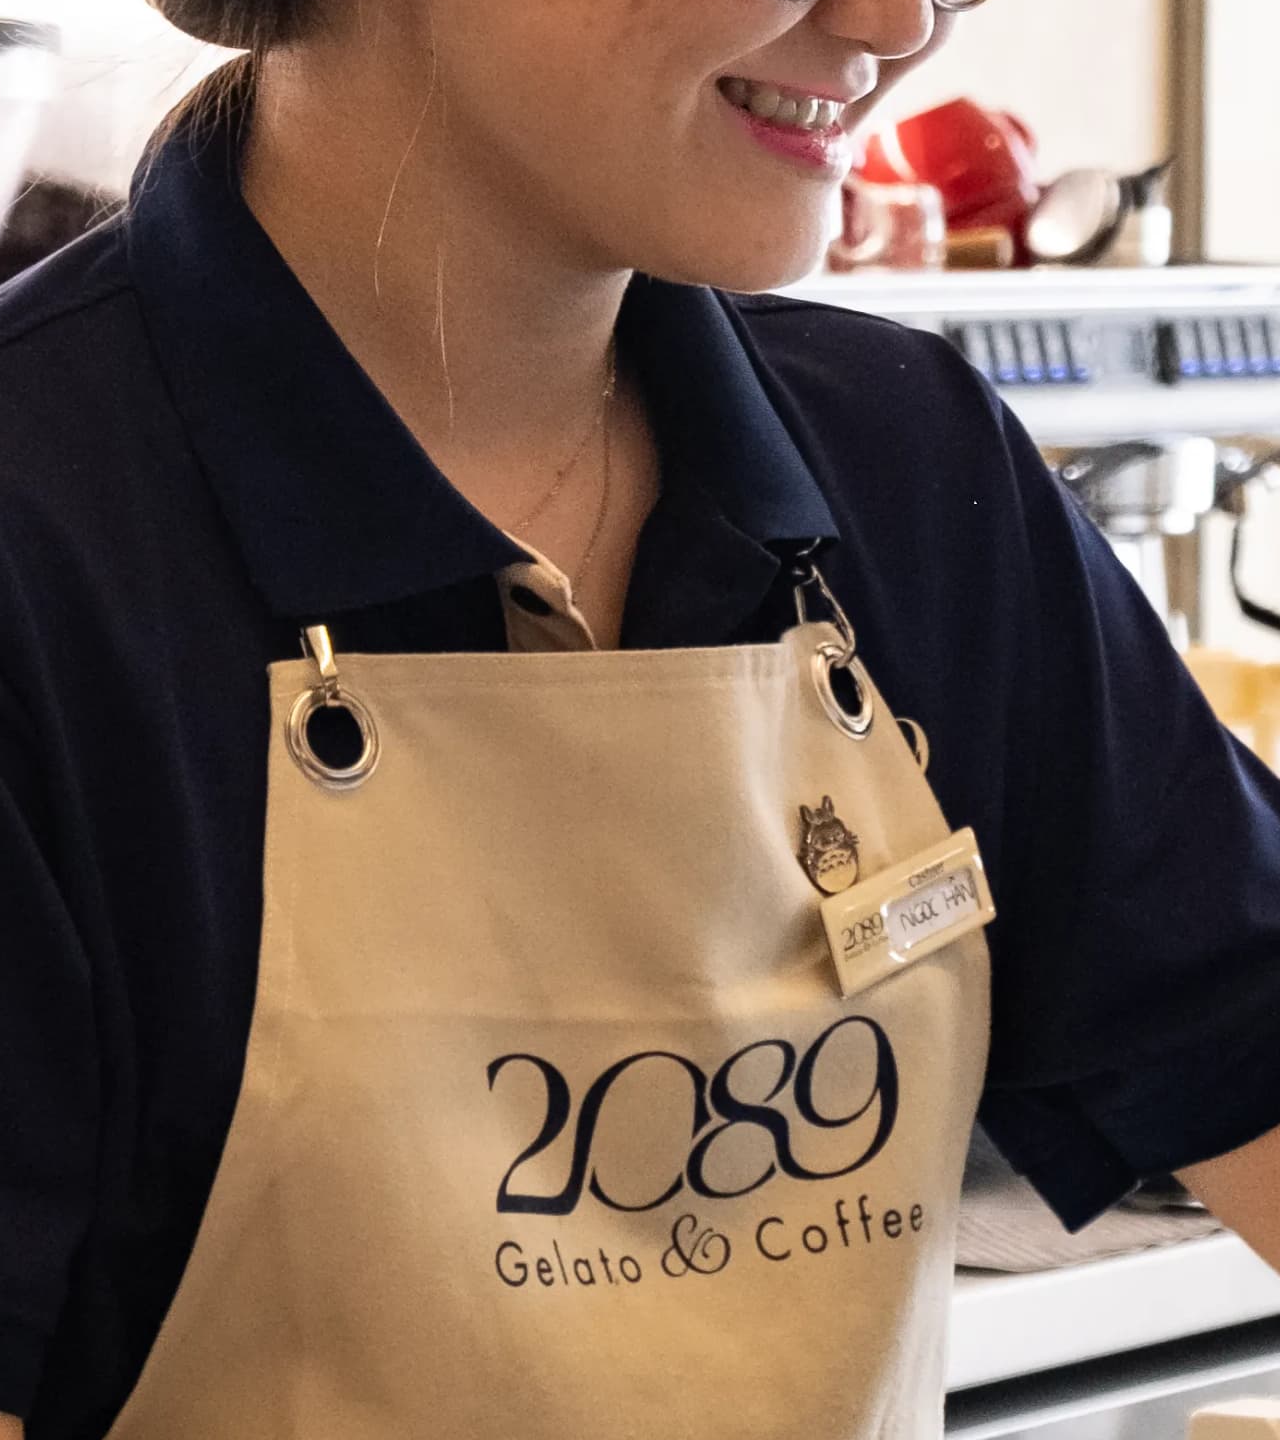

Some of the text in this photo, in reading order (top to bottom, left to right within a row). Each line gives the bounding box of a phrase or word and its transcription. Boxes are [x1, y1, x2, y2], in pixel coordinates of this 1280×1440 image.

[487, 1016, 898, 1215] 2089
[495, 1195, 924, 1287] Gelato & Coffee
